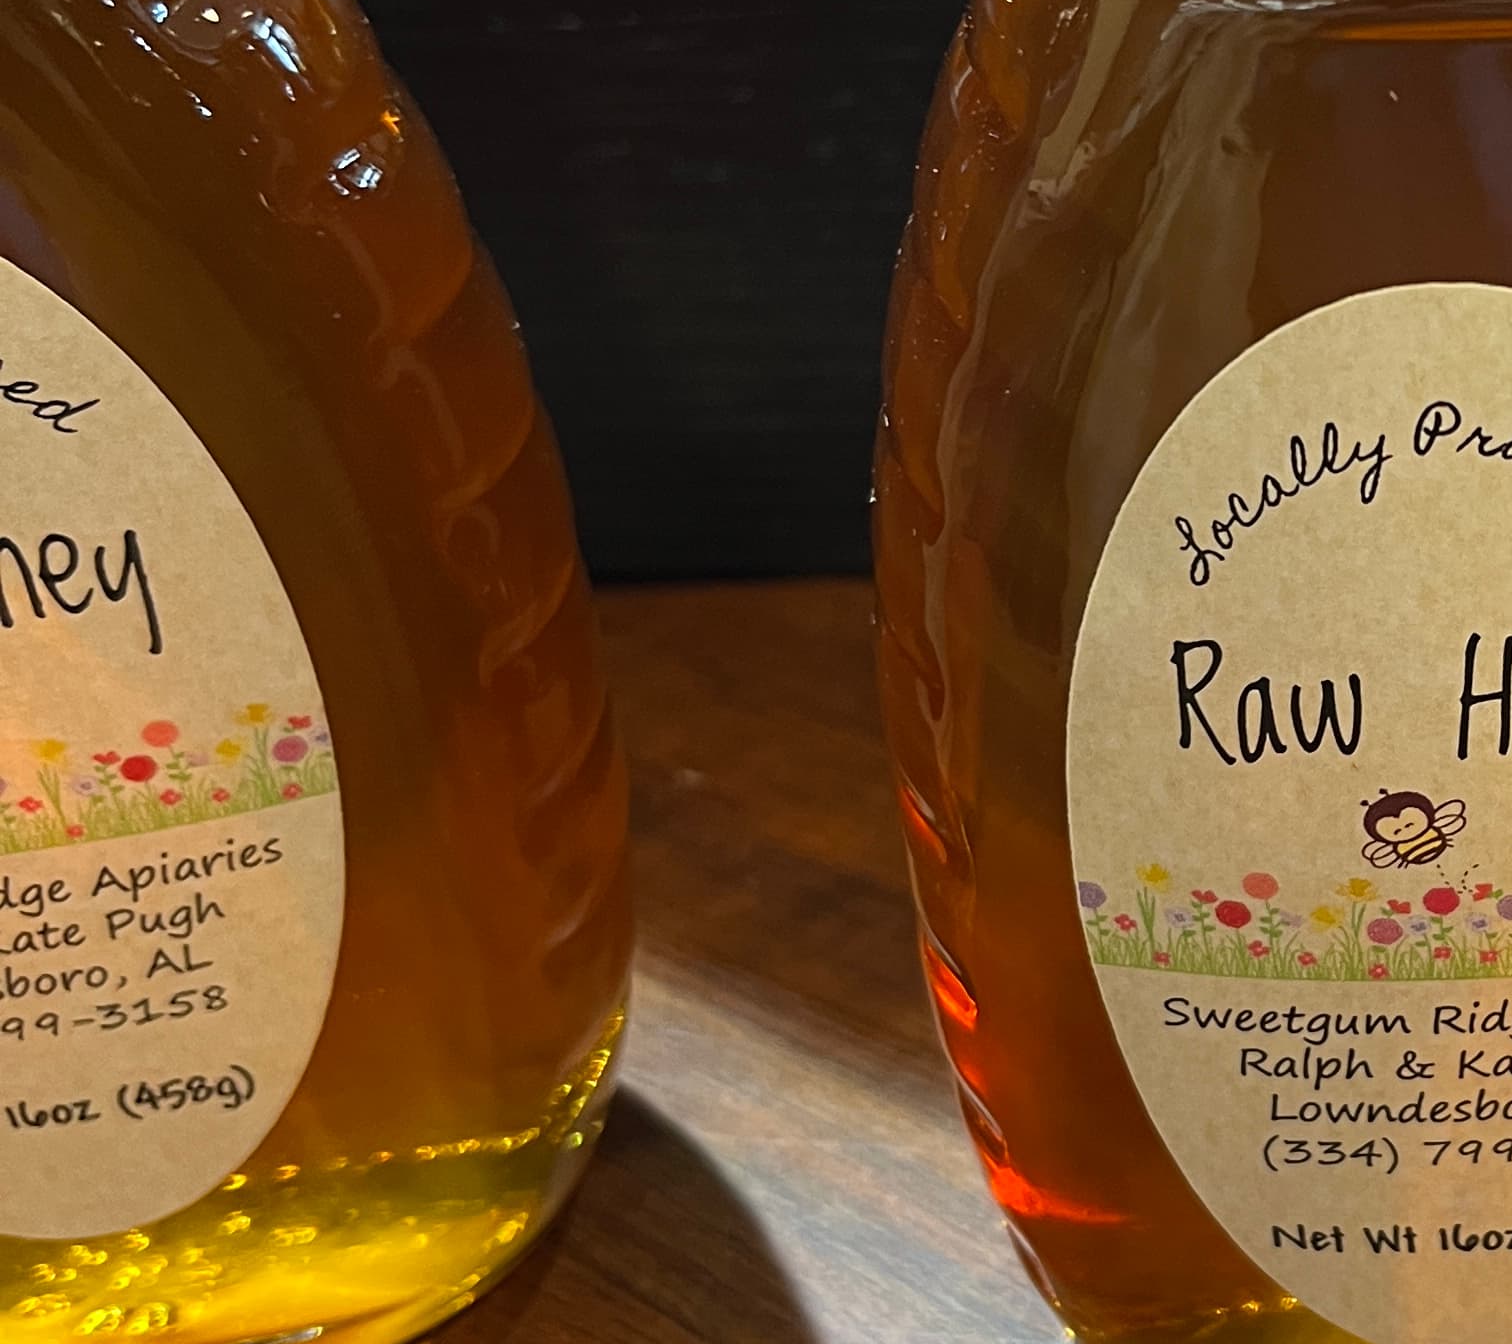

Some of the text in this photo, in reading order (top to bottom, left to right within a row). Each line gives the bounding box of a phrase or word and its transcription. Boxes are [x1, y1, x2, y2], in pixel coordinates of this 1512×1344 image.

[1175, 422, 1394, 587] Locally
[0, 529, 163, 655] ney
[1170, 638, 1363, 767] Raw
[0, 837, 284, 918] dge Apiaries
[105, 891, 226, 940] Pugh
[146, 943, 214, 979] AL
[0, 984, 229, 1042] 99-3158
[1162, 995, 1413, 1044] Sweetgum
[1239, 1046, 1373, 1091] Ralph
[1395, 1049, 1436, 1081] &
[6, 1063, 257, 1130] 16oz (458g)
[1262, 1135, 1402, 1176] (334)
[1270, 1222, 1346, 1255] Net
[1362, 1224, 1418, 1255] Wt
